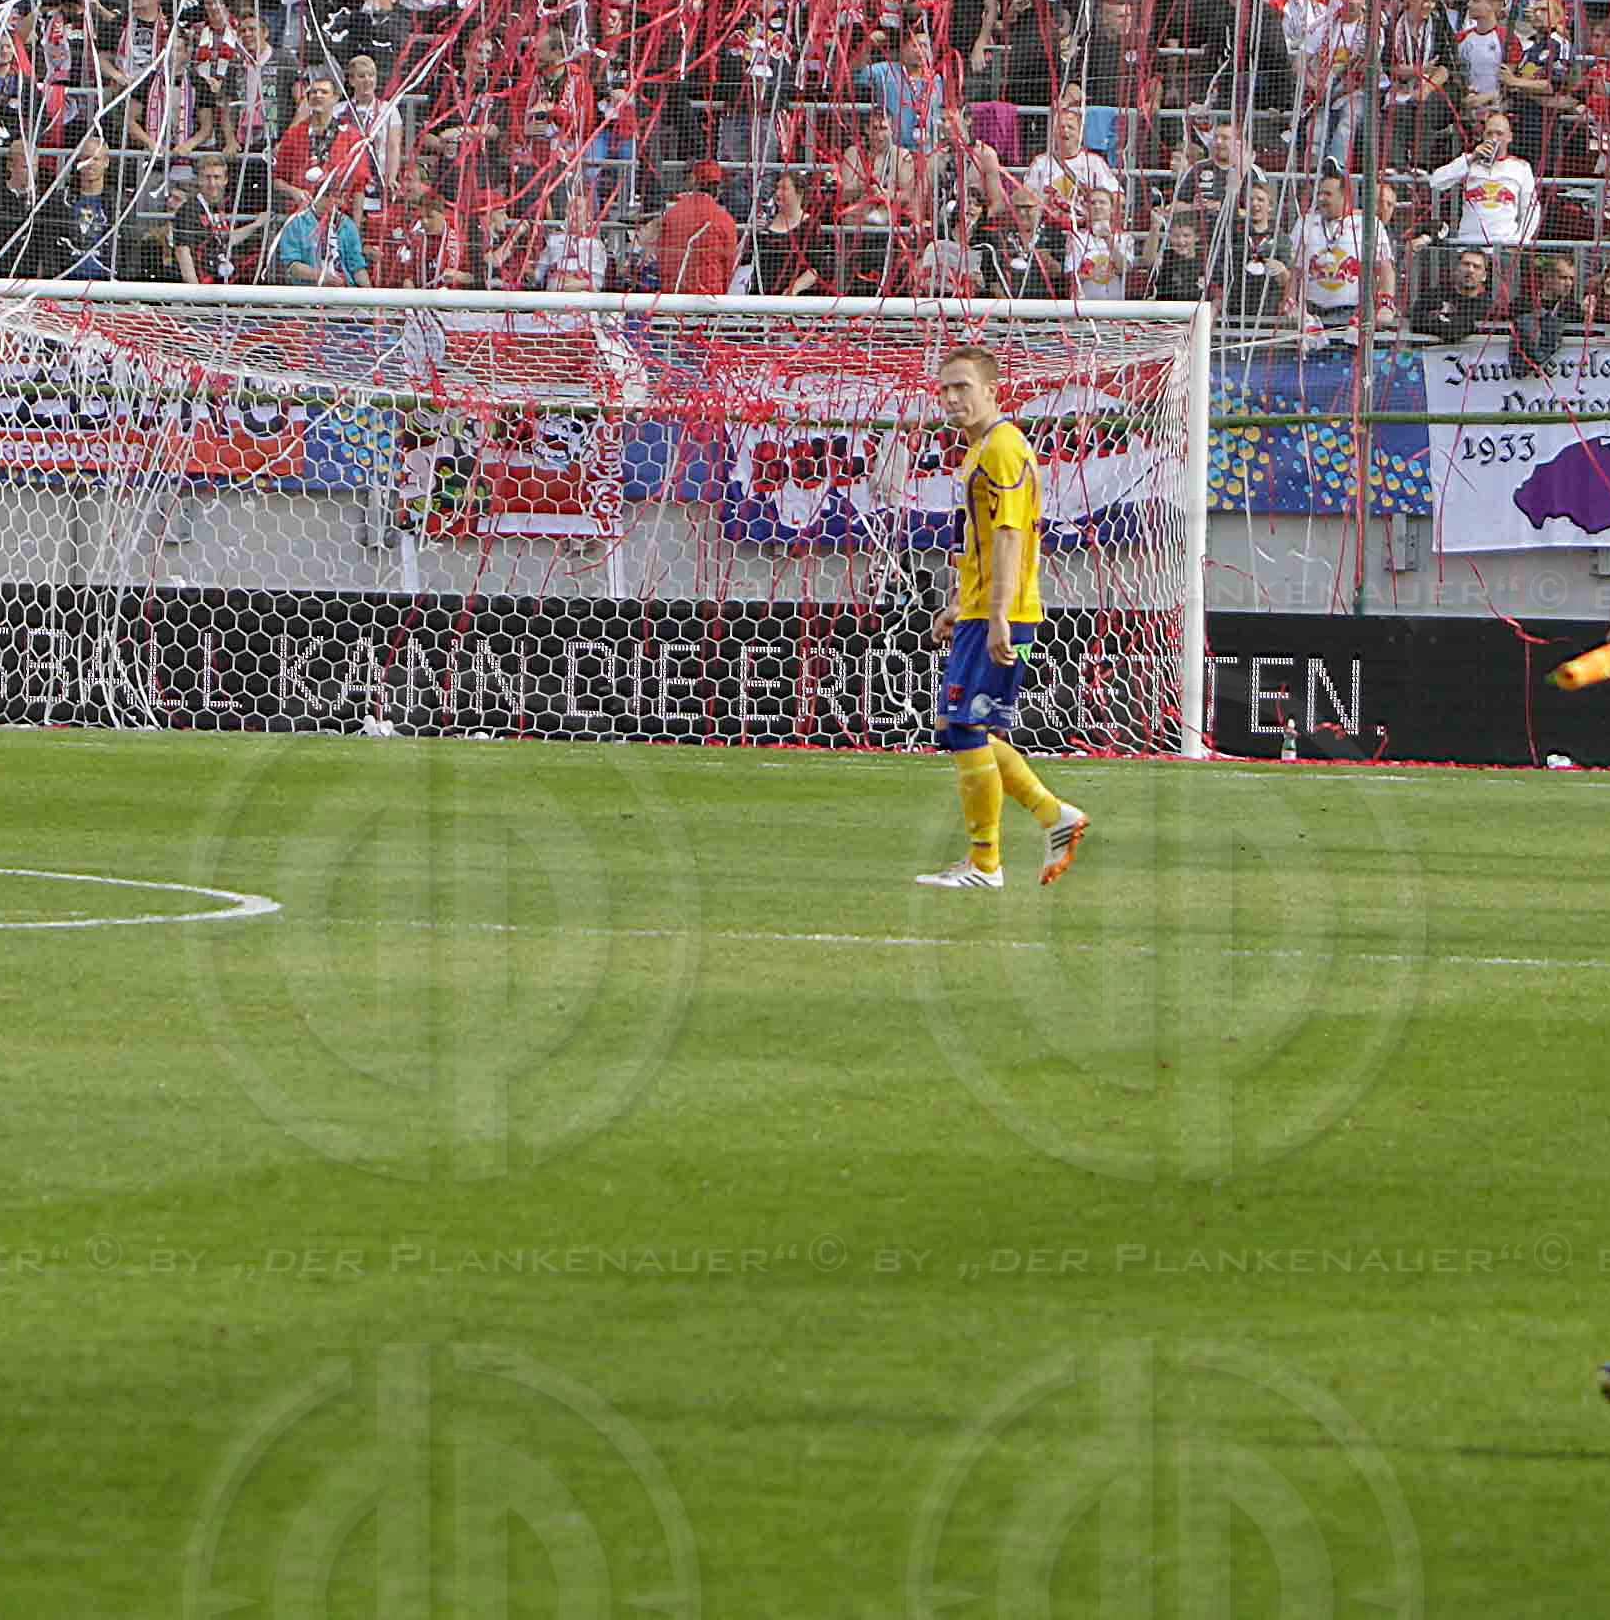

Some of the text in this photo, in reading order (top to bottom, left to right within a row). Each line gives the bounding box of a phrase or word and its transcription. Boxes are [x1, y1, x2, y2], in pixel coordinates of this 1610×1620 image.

[1461, 432, 1536, 465] 1933
[279, 635, 524, 715] KANN
[565, 641, 703, 719] DIE
